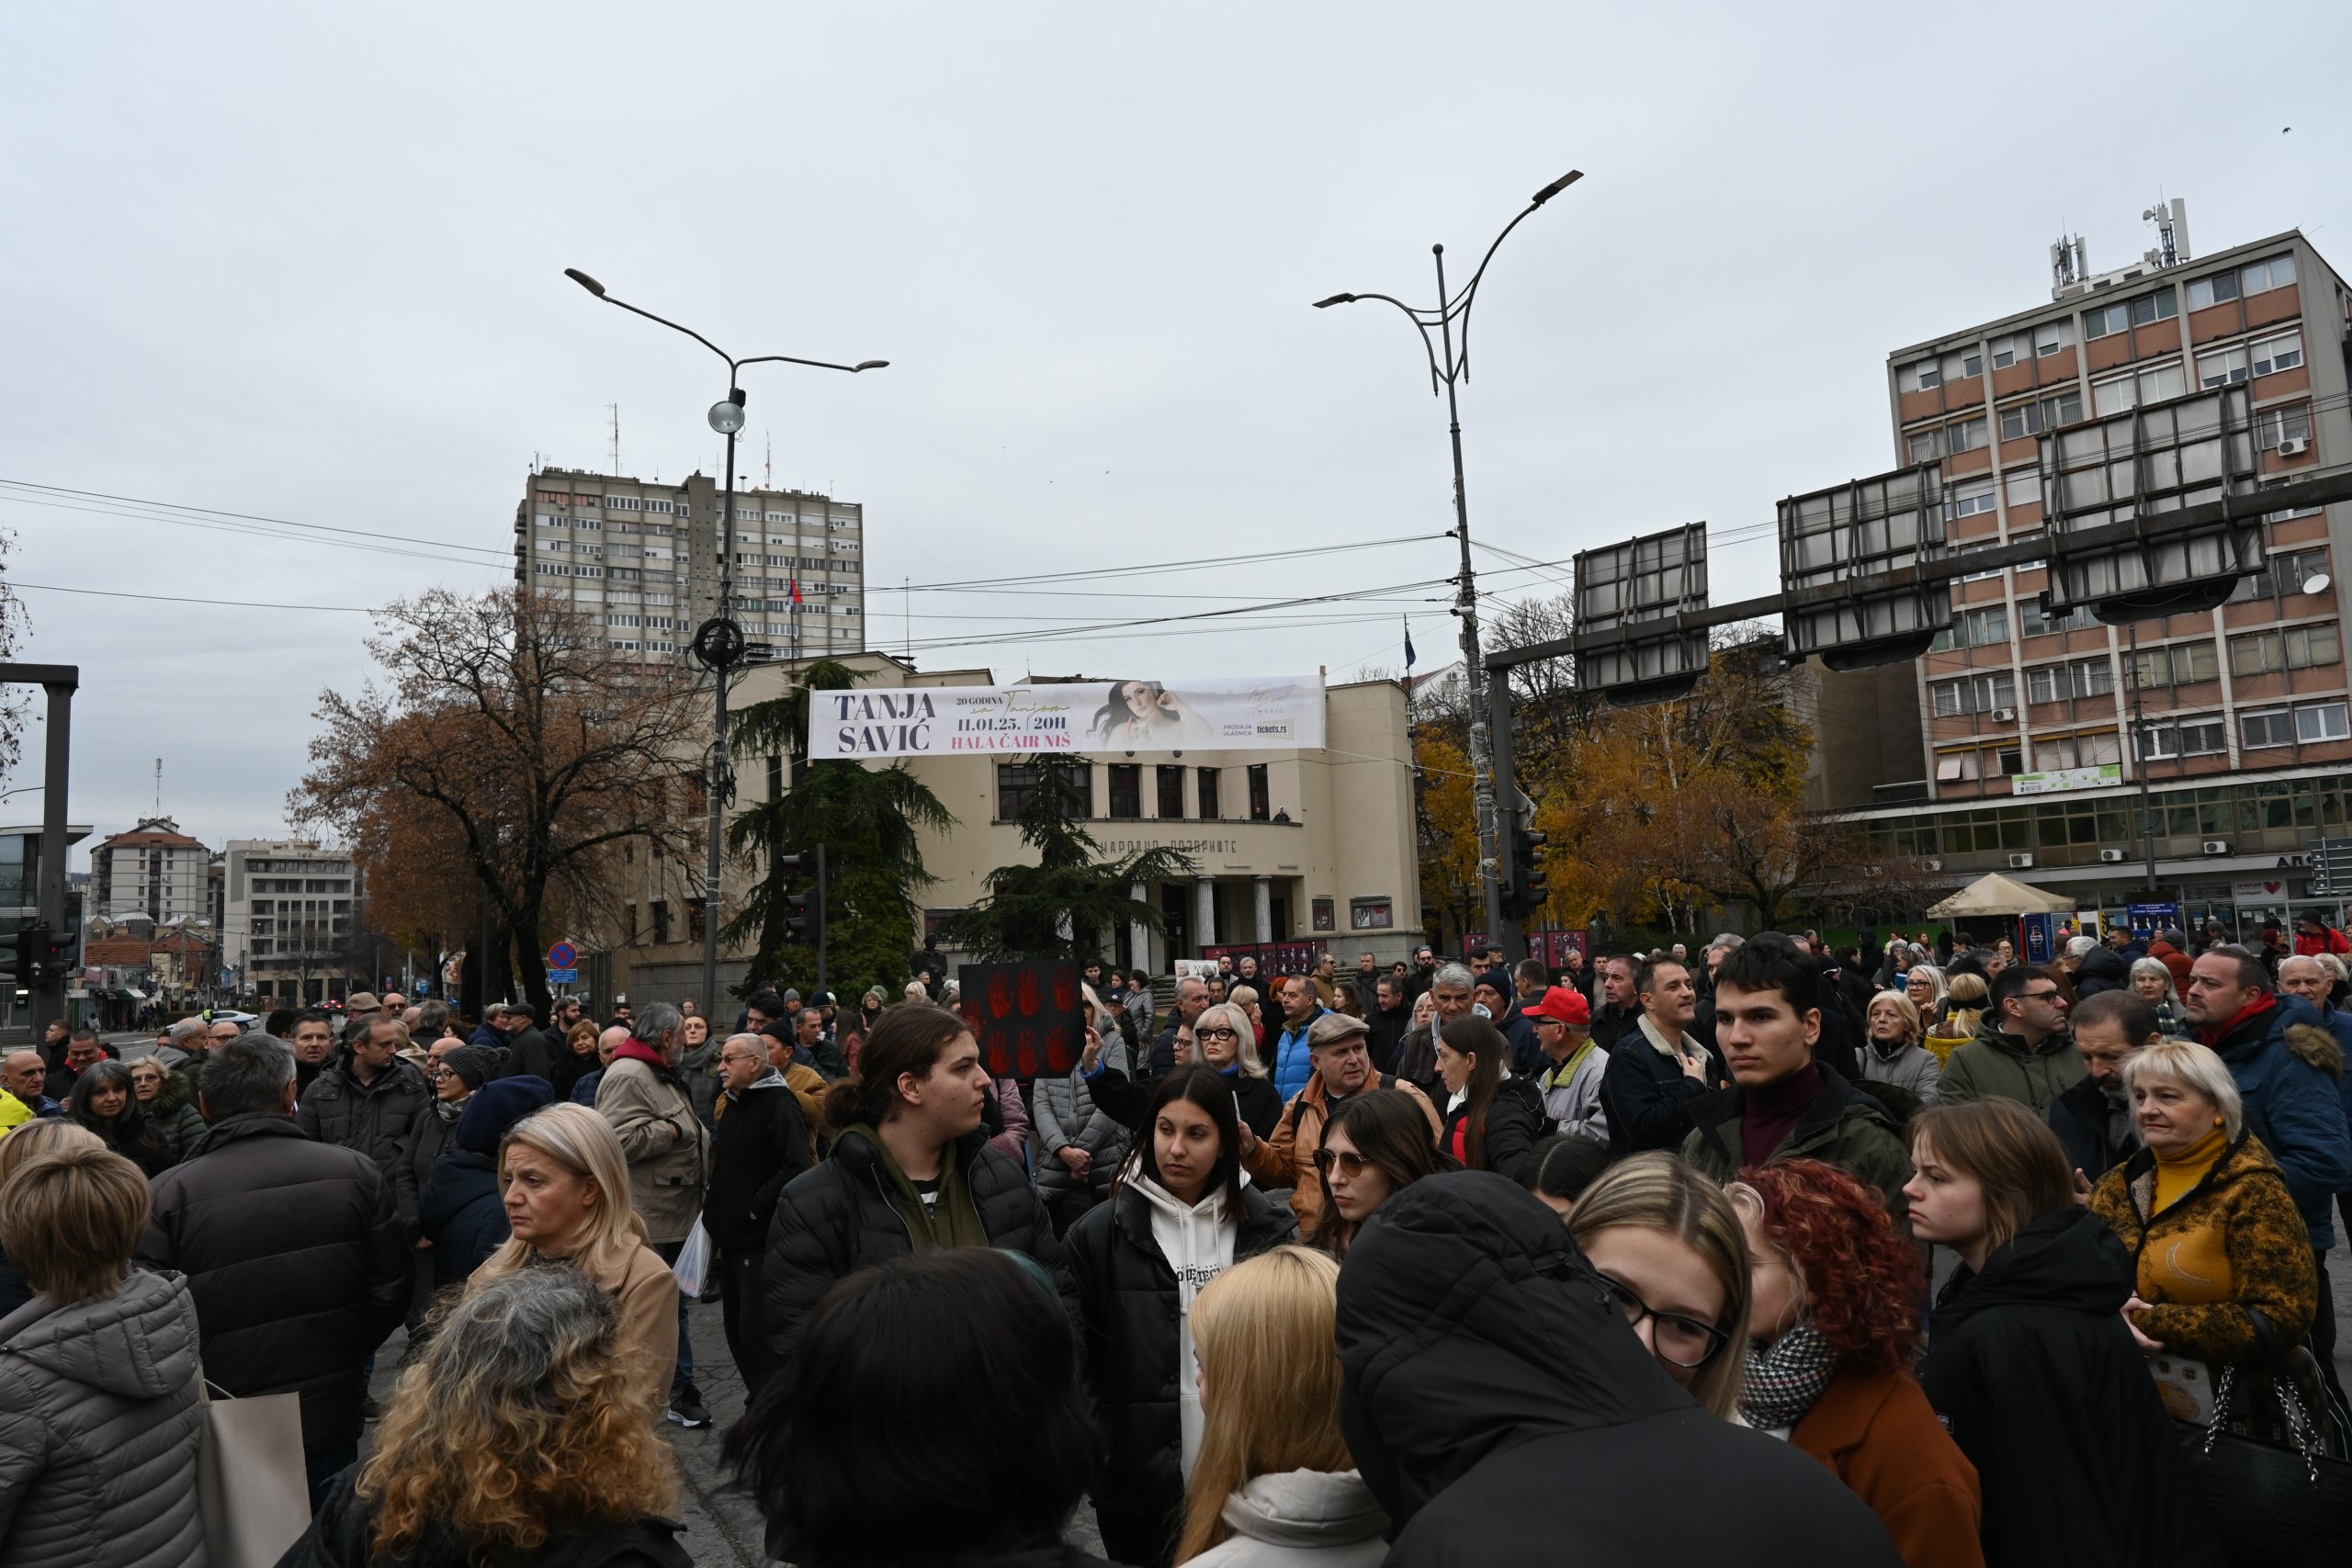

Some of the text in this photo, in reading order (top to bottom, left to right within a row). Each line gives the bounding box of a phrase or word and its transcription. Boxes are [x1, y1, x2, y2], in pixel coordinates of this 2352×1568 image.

[834, 692, 937, 721] TANJA
[956, 696, 1003, 705] 20 GODINA
[957, 716, 1067, 732] 11.01.25. 20H
[1257, 724, 1287, 734] tickets.rs
[838, 717, 931, 753] SAVIĆ
[951, 731, 1071, 750] HALA ČAIR NIŠ
